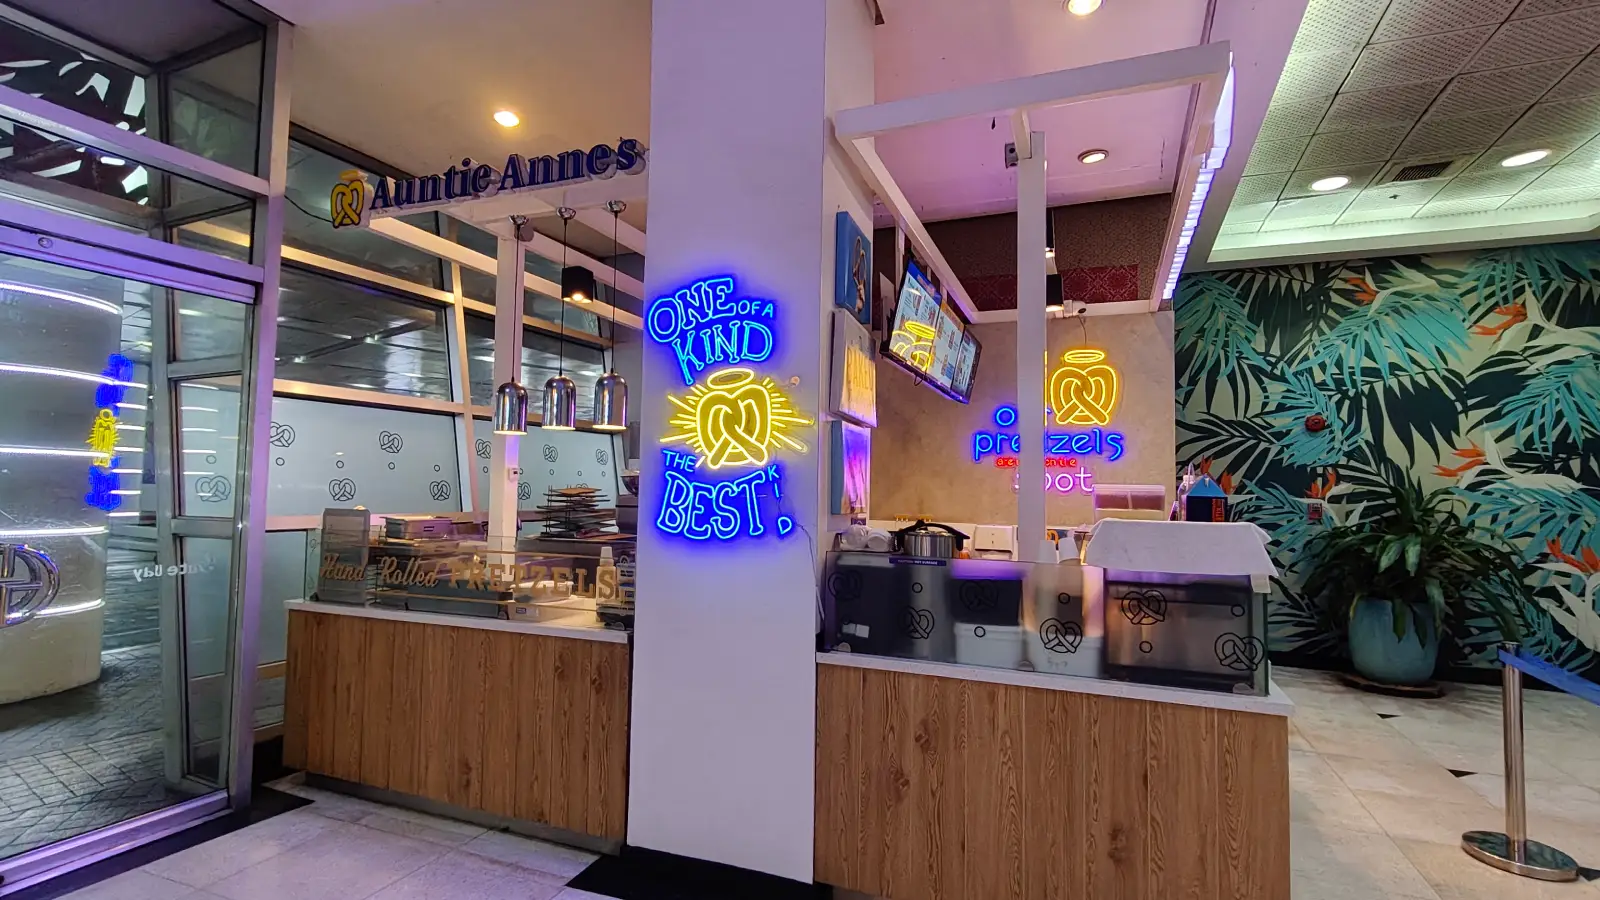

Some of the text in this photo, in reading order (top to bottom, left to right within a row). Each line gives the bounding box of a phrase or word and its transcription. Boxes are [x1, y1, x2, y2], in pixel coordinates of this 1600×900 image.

[369, 157, 492, 210] Auntie
[648, 277, 774, 342] ONE OF A
[671, 319, 773, 385] KIND
[662, 449, 697, 472] THE
[974, 428, 1124, 461] prezels
[656, 469, 766, 540] BEST
[320, 552, 617, 600] Hand Rolled PRETZELS
